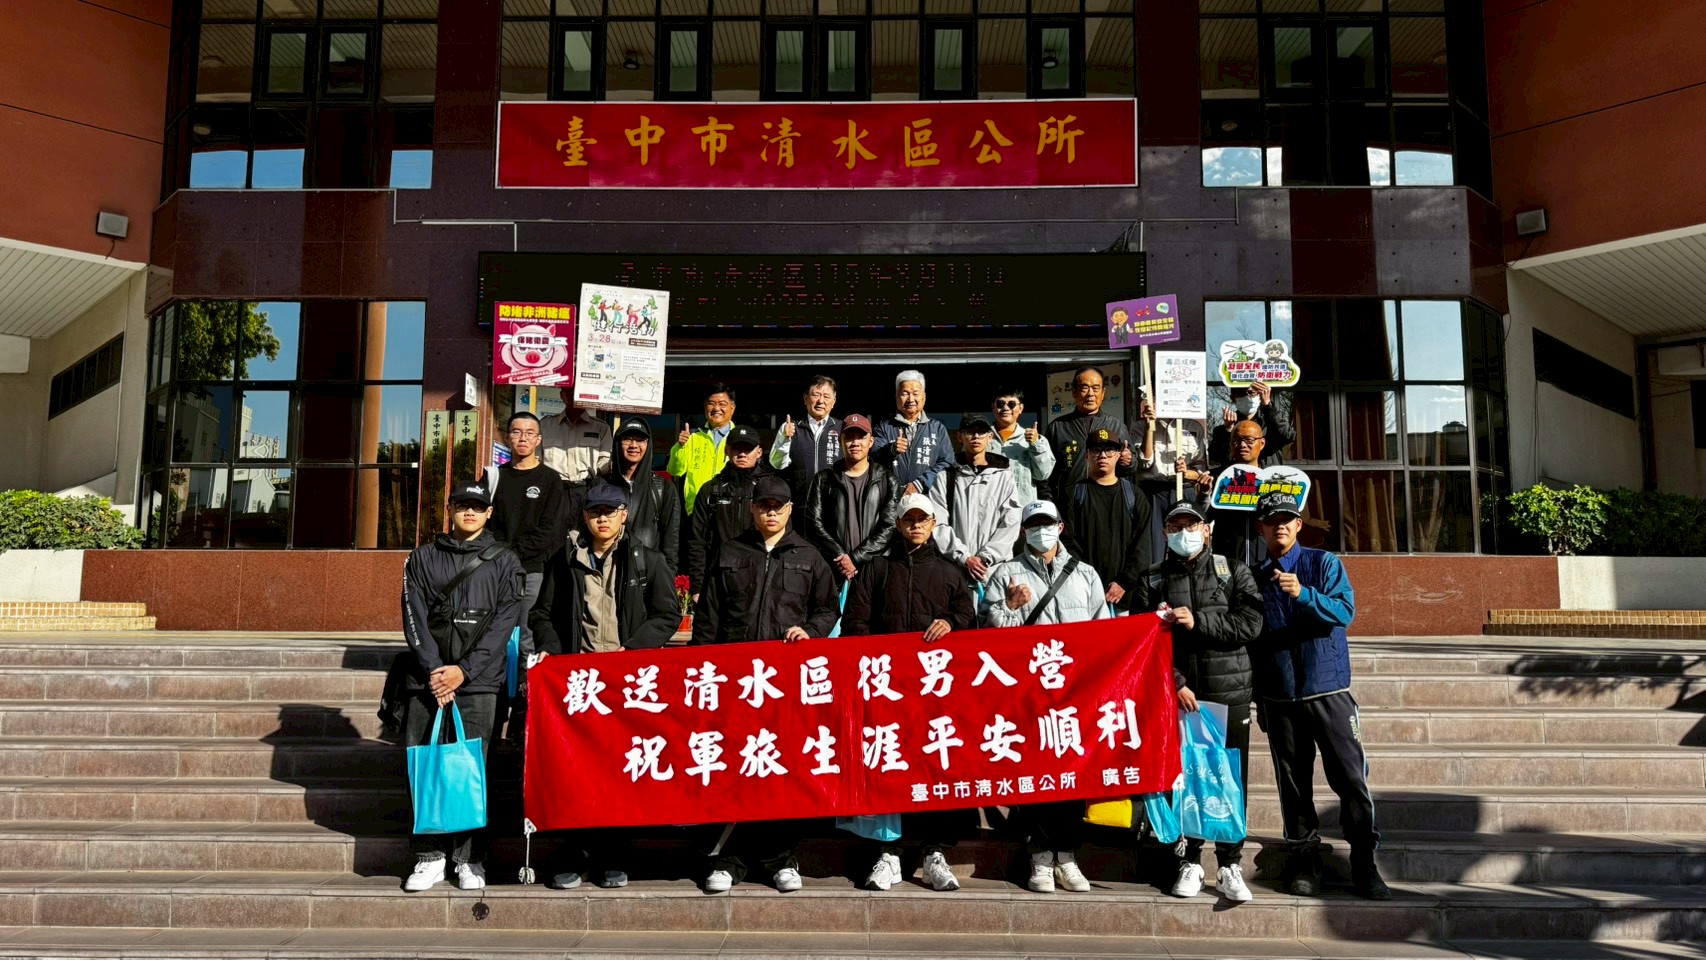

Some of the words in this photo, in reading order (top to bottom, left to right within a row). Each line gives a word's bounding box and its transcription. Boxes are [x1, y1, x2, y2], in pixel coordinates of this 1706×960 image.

[555, 113, 1086, 170] 臺中市清水區公所
[562, 638, 1074, 716] 歡送清水區役男入營
[622, 698, 1142, 787] 祝軍旅生涯平安順利
[910, 771, 1076, 803] 臺中市清水區公所
[1102, 766, 1141, 788] 廣告
